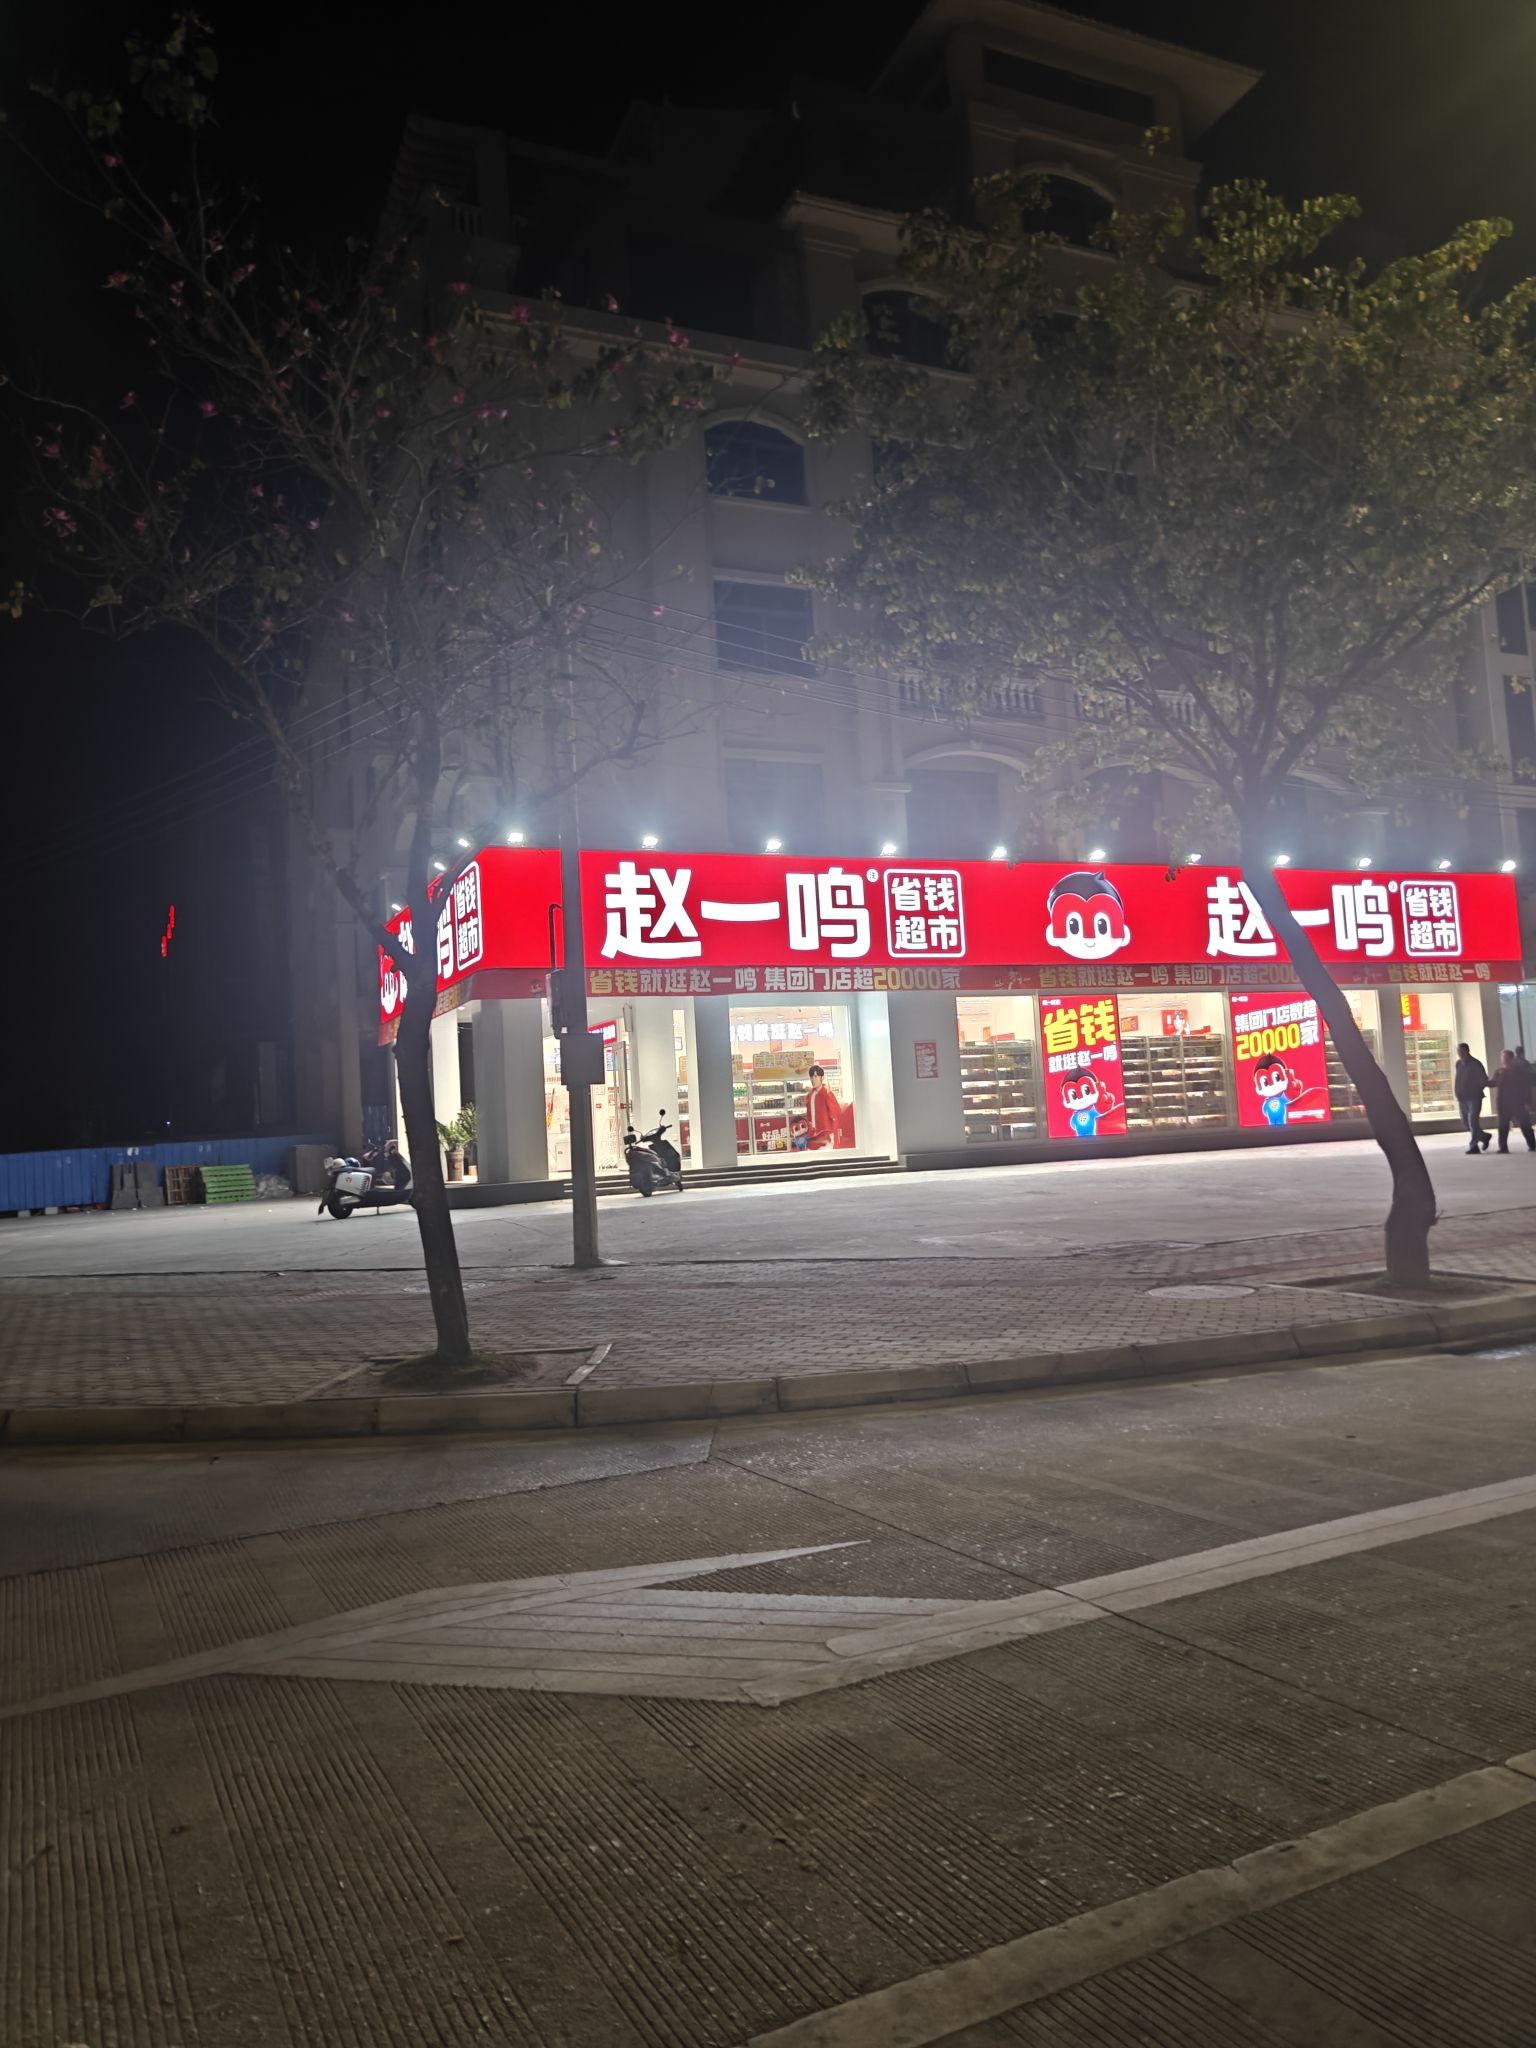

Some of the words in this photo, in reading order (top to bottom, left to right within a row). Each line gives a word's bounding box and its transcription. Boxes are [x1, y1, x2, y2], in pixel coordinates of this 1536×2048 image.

[456, 871, 477, 920] 省钱
[601, 861, 870, 959] 赵一鸣
[890, 877, 956, 913] 省钱
[1405, 887, 1453, 917] 省钱
[894, 915, 959, 951] 超市
[1206, 876, 1395, 957] 赵一鸣
[458, 917, 479, 962] 超市
[1409, 919, 1456, 950] 超市
[589, 967, 757, 994] 省钱就逛赵一鸣
[764, 966, 960, 991] 集团门店超20000家
[1039, 965, 1169, 987] 省钱就逛赵一鸣
[1388, 963, 1490, 982] 省钱就逛赵一鸣
[729, 1022, 834, 1042] 钱就逛赵一鸣
[1044, 999, 1116, 1053] 省钱
[1235, 1000, 1317, 1033] 集团门店数超
[1236, 1020, 1319, 1060] 20000家
[1048, 1044, 1117, 1073] 就逛赵一鸣
